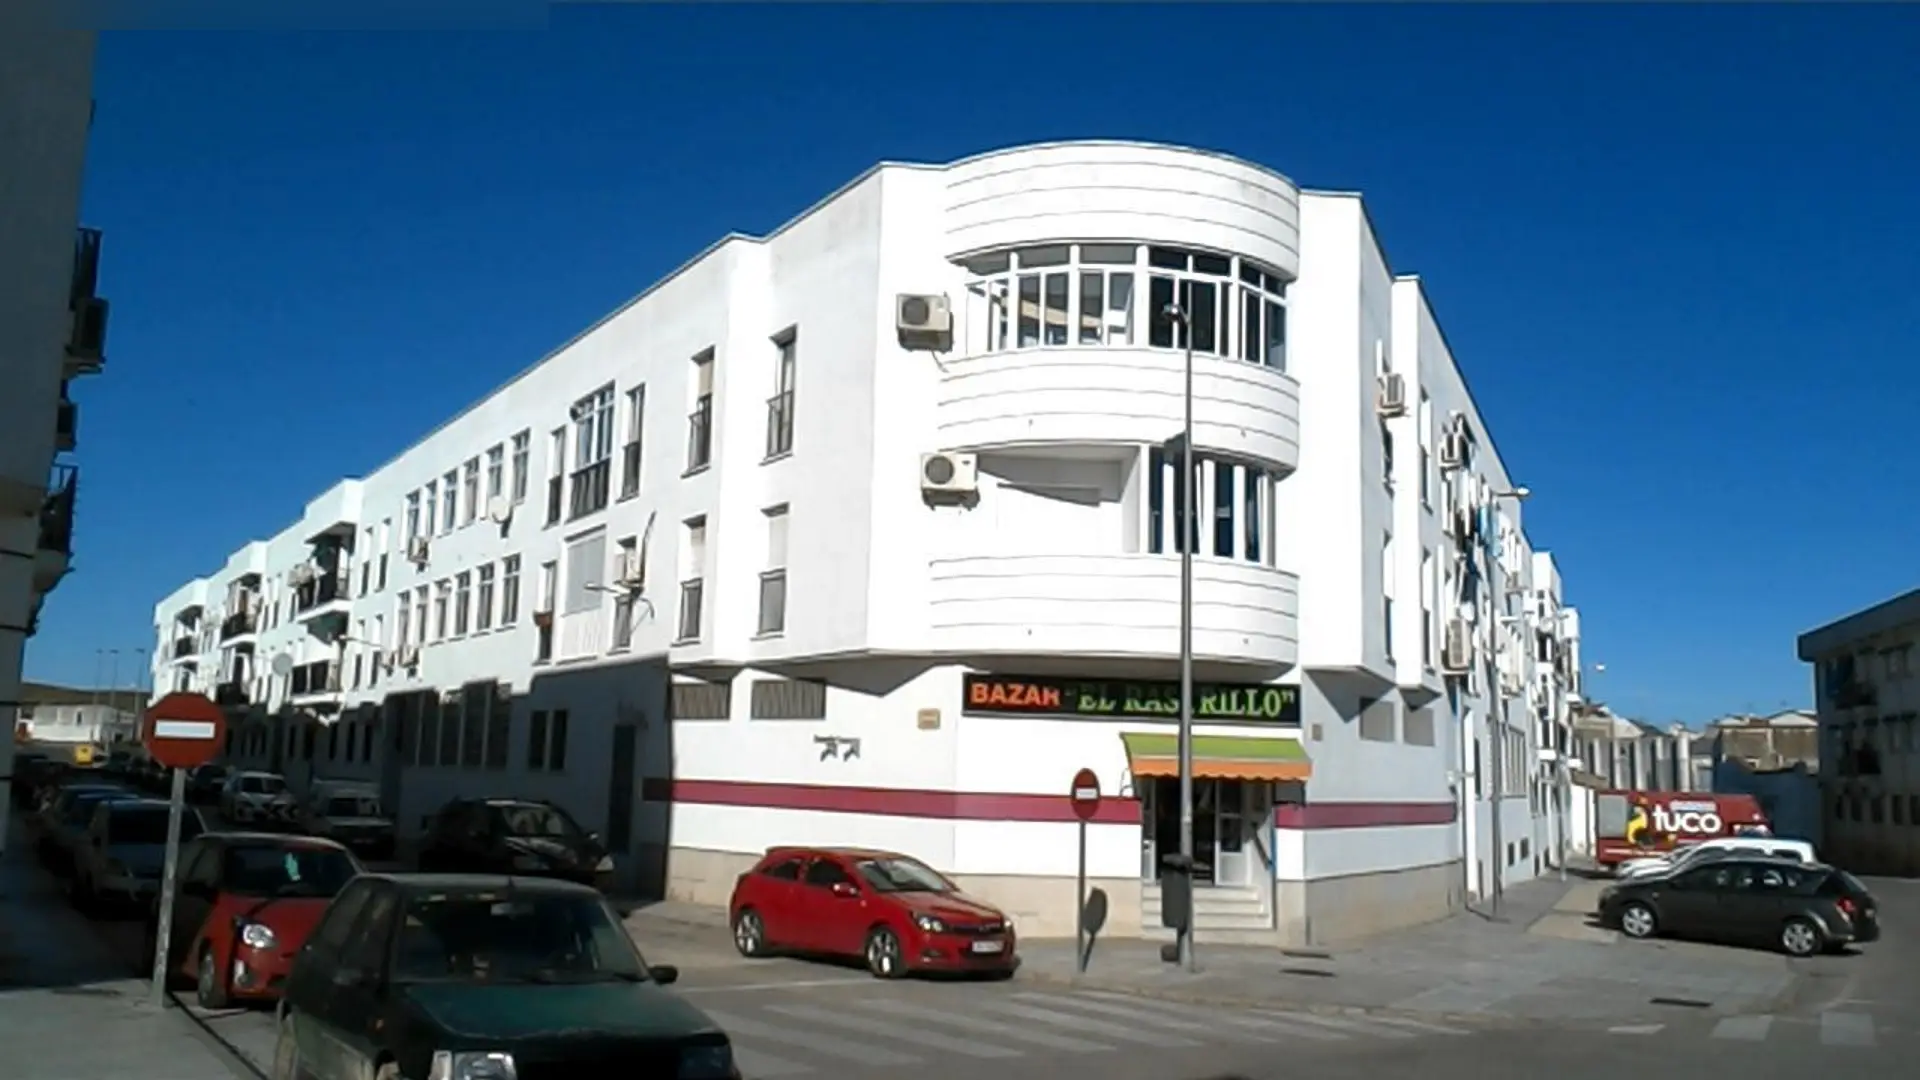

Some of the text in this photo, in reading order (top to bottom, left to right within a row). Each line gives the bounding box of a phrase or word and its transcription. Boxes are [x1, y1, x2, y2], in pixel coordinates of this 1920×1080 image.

[970, 682, 1061, 707] BAZAR
[1123, 683, 1295, 717] RASRILLO"
[1653, 803, 1721, 832] tuco
